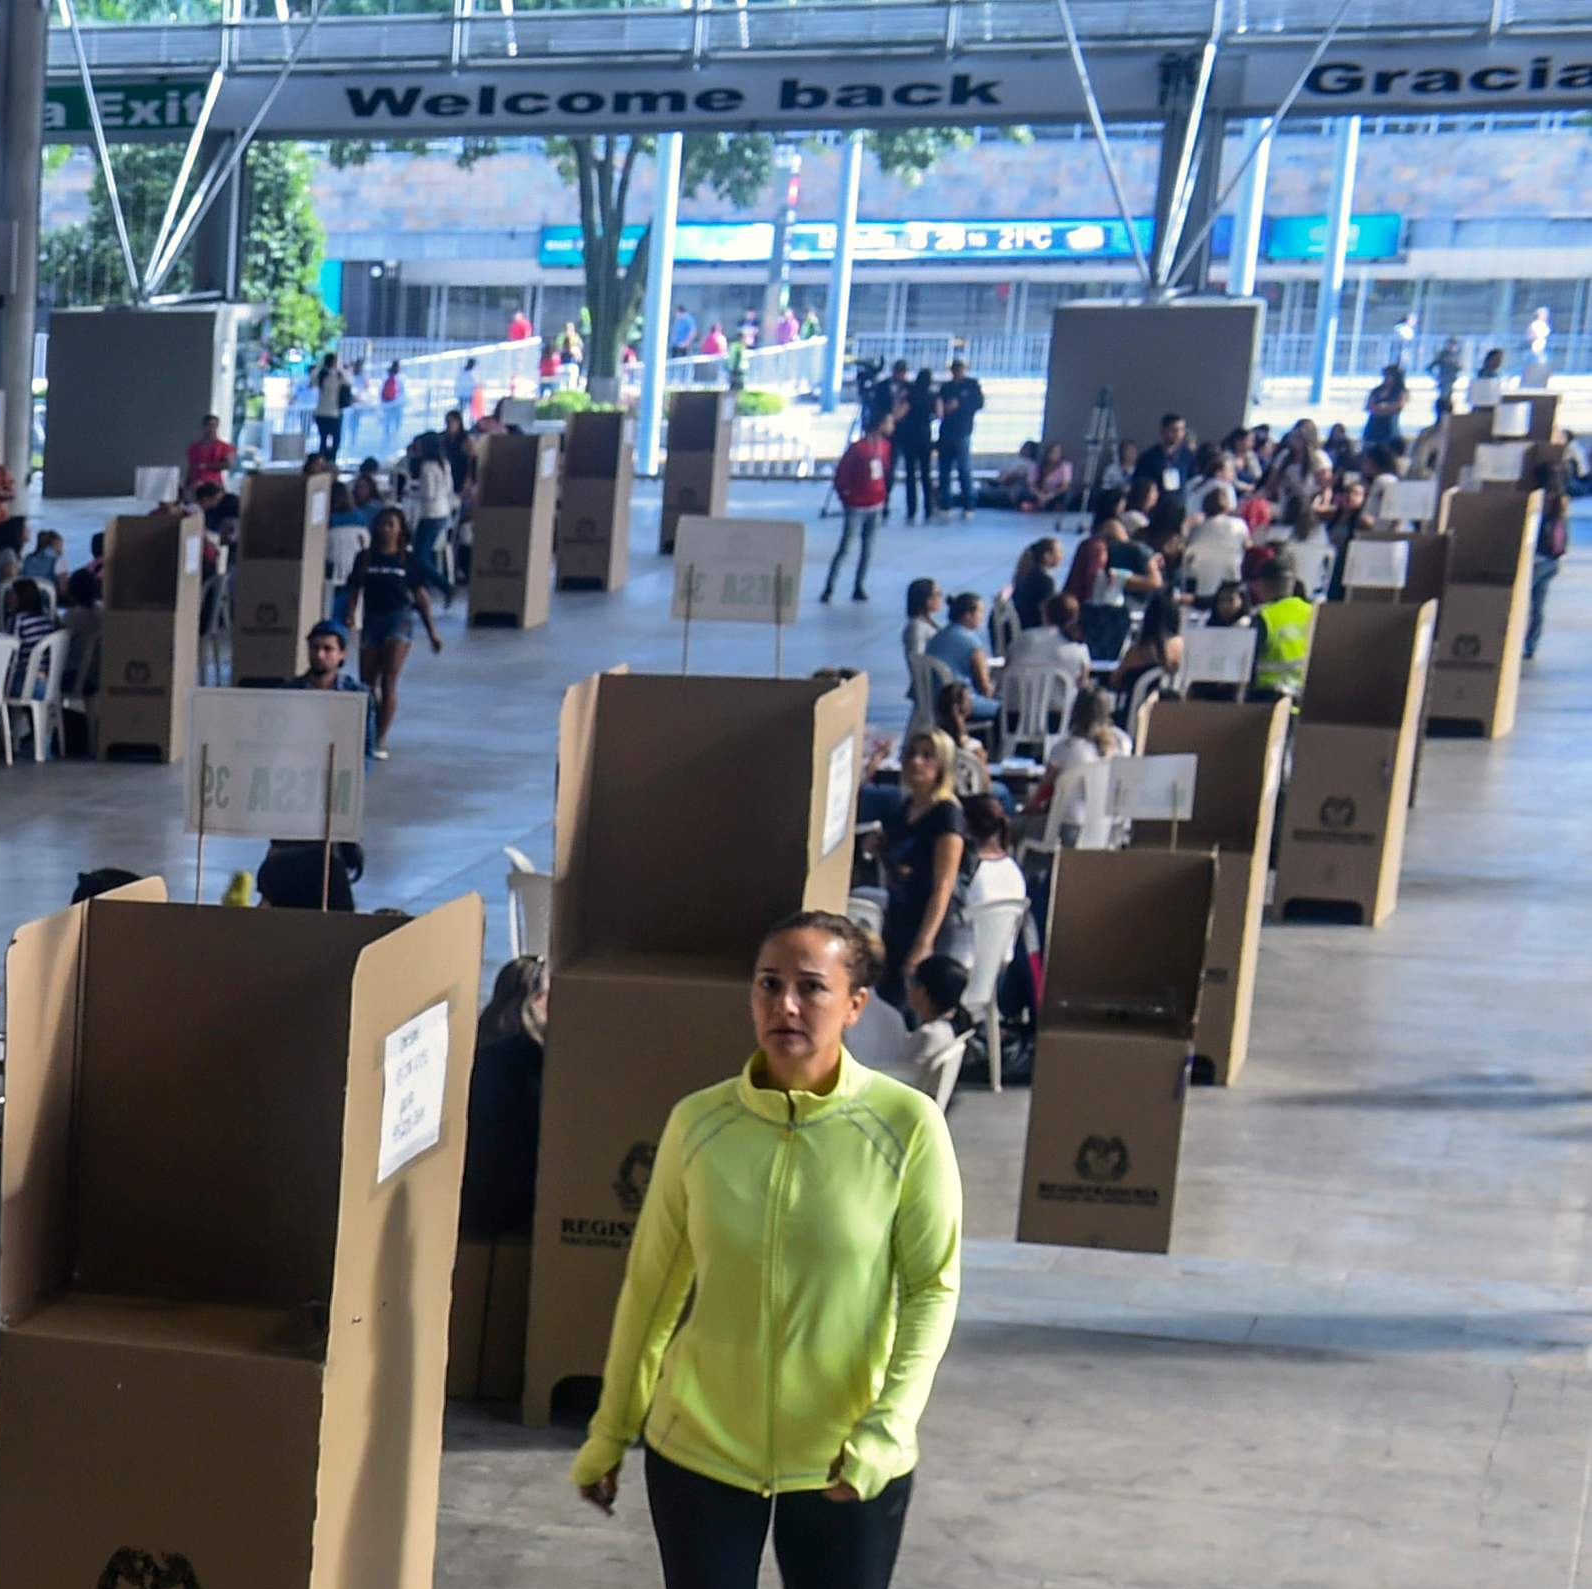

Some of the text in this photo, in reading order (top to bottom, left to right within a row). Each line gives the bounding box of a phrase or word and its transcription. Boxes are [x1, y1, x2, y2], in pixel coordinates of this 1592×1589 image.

[99, 89, 207, 127] Exit
[344, 74, 1002, 119] Welcome back
